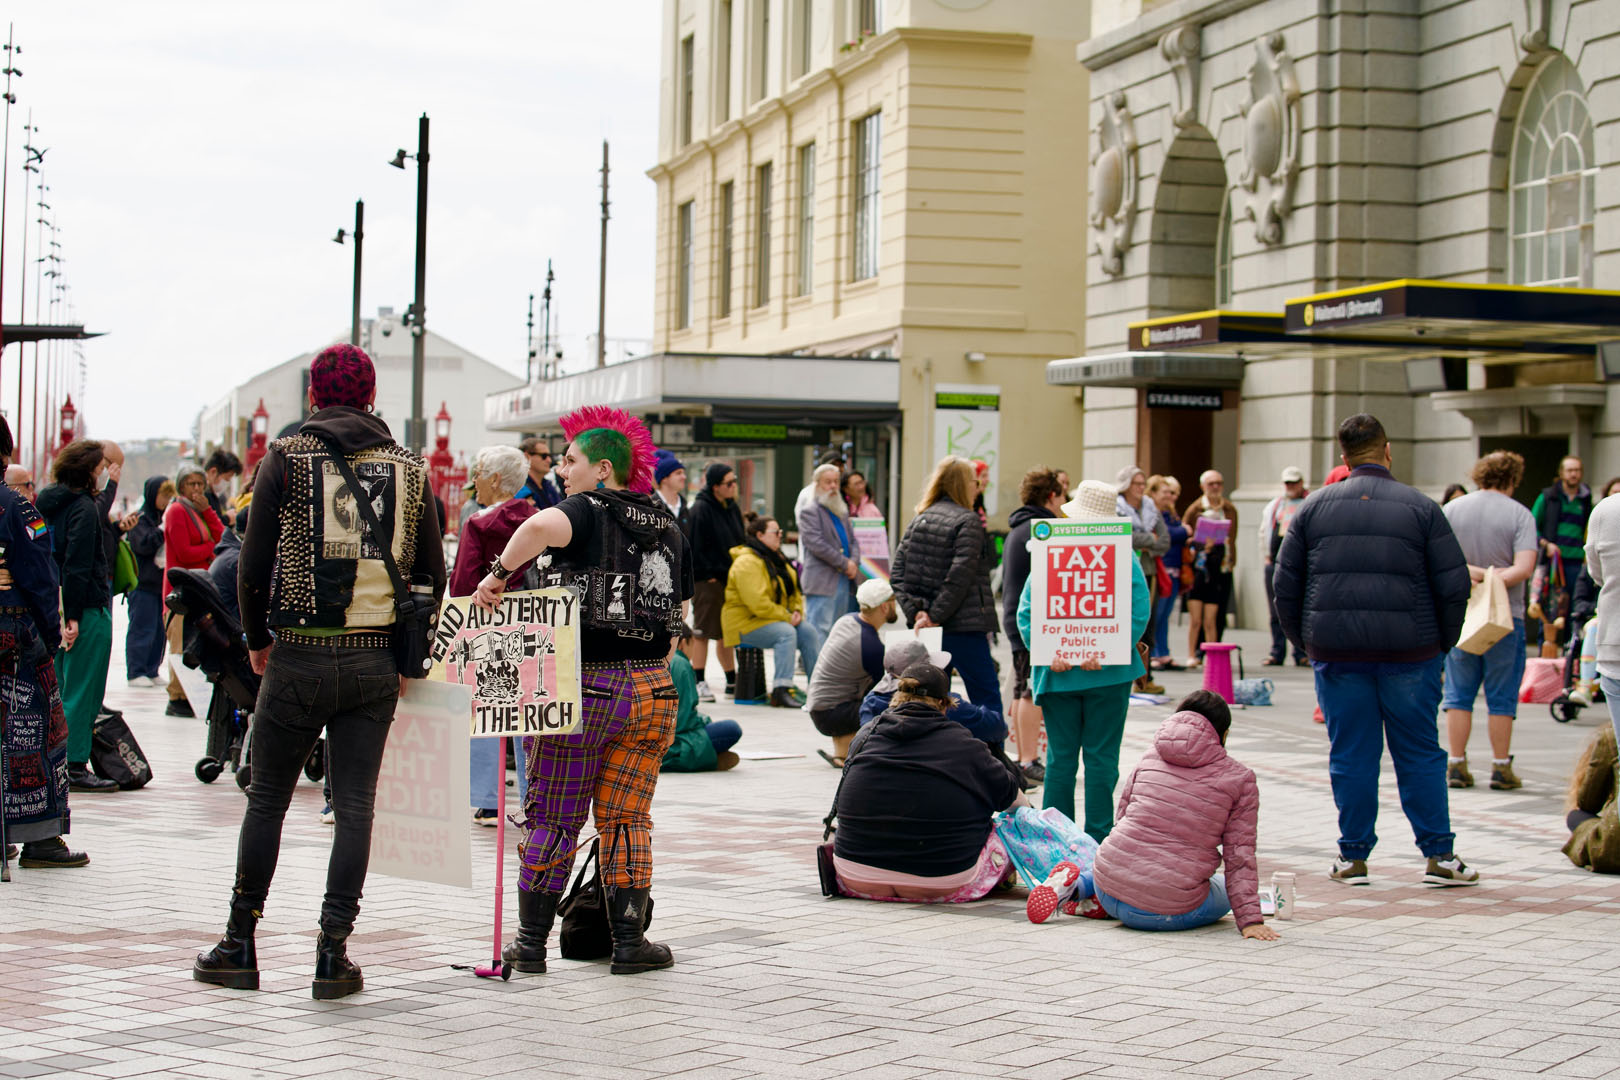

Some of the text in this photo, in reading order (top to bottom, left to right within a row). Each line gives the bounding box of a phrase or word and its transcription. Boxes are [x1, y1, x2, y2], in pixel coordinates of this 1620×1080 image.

[1148, 393, 1221, 407] STARBUCKS
[1054, 525, 1123, 535] SYSTEM CHANGE
[1049, 546, 1108, 570] TAX
[1057, 571, 1106, 593] THE
[635, 594, 673, 610] ANGER
[1050, 594, 1113, 617] RICH
[432, 596, 575, 663] END AUSTERITY
[1042, 623, 1119, 635] For Universal
[1061, 636, 1097, 647] Public
[1055, 649, 1106, 660] Services
[476, 701, 573, 734] THE RICH
[13, 727, 36, 735] CENSOR
[13, 736, 36, 746] MYSELF
